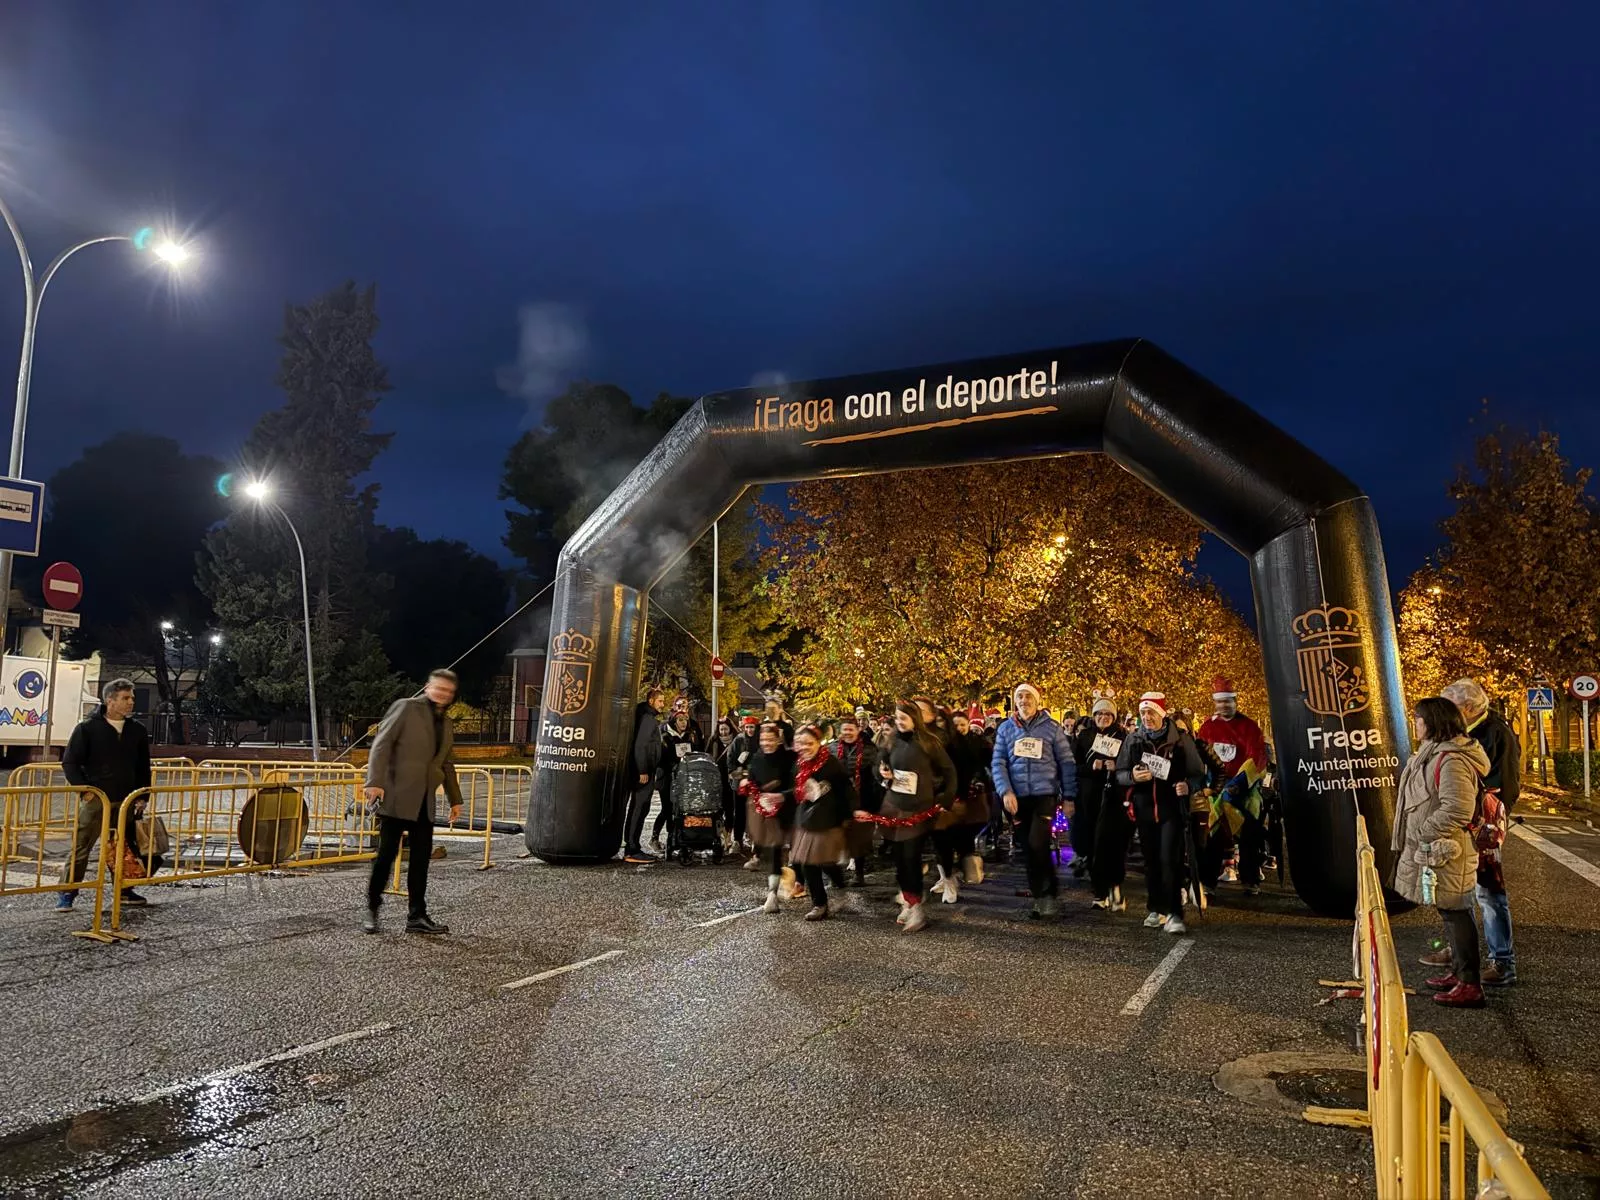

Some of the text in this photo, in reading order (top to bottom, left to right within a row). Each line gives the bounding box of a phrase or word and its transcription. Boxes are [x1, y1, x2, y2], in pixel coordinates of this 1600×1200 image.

[754, 360, 1059, 432] ¡Fraga con el deporte!
[1576, 681, 1595, 691] 20
[0, 707, 49, 727] ANGA
[541, 720, 586, 743] Fraga
[1307, 727, 1383, 751] Fraga
[1297, 754, 1400, 776] Ayuntamiento
[1307, 773, 1396, 795] Ajuntament
